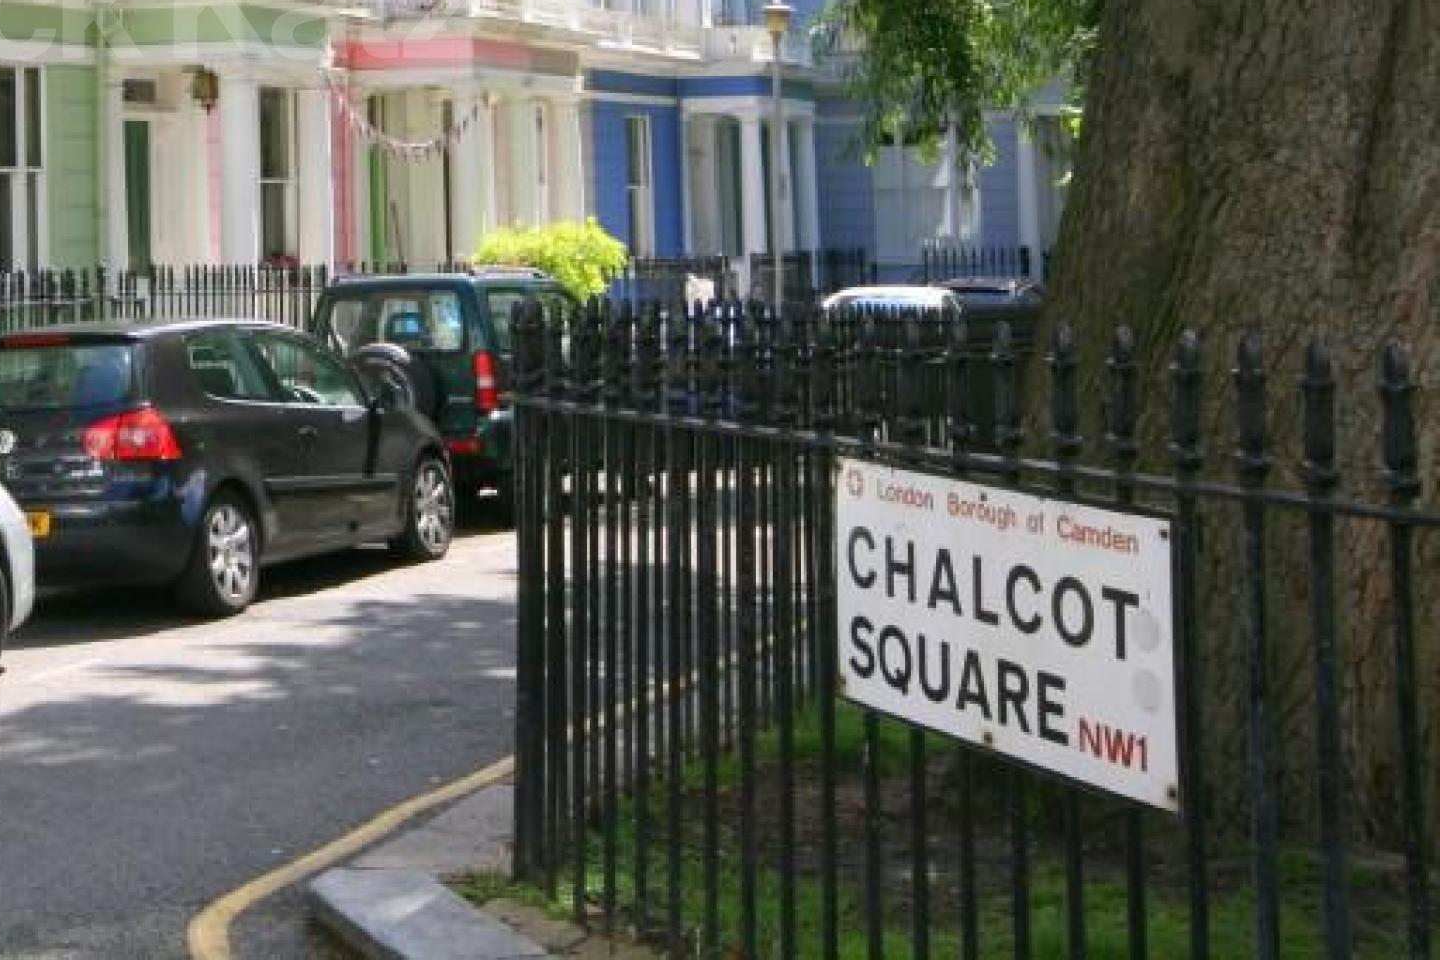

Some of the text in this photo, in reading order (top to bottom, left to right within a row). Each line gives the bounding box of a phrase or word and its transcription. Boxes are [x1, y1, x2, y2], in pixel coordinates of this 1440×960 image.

[877, 477, 1140, 555] London Borough of Camden
[847, 525, 1140, 662] CHALCOT
[848, 615, 1148, 773] SQUARE NW1
